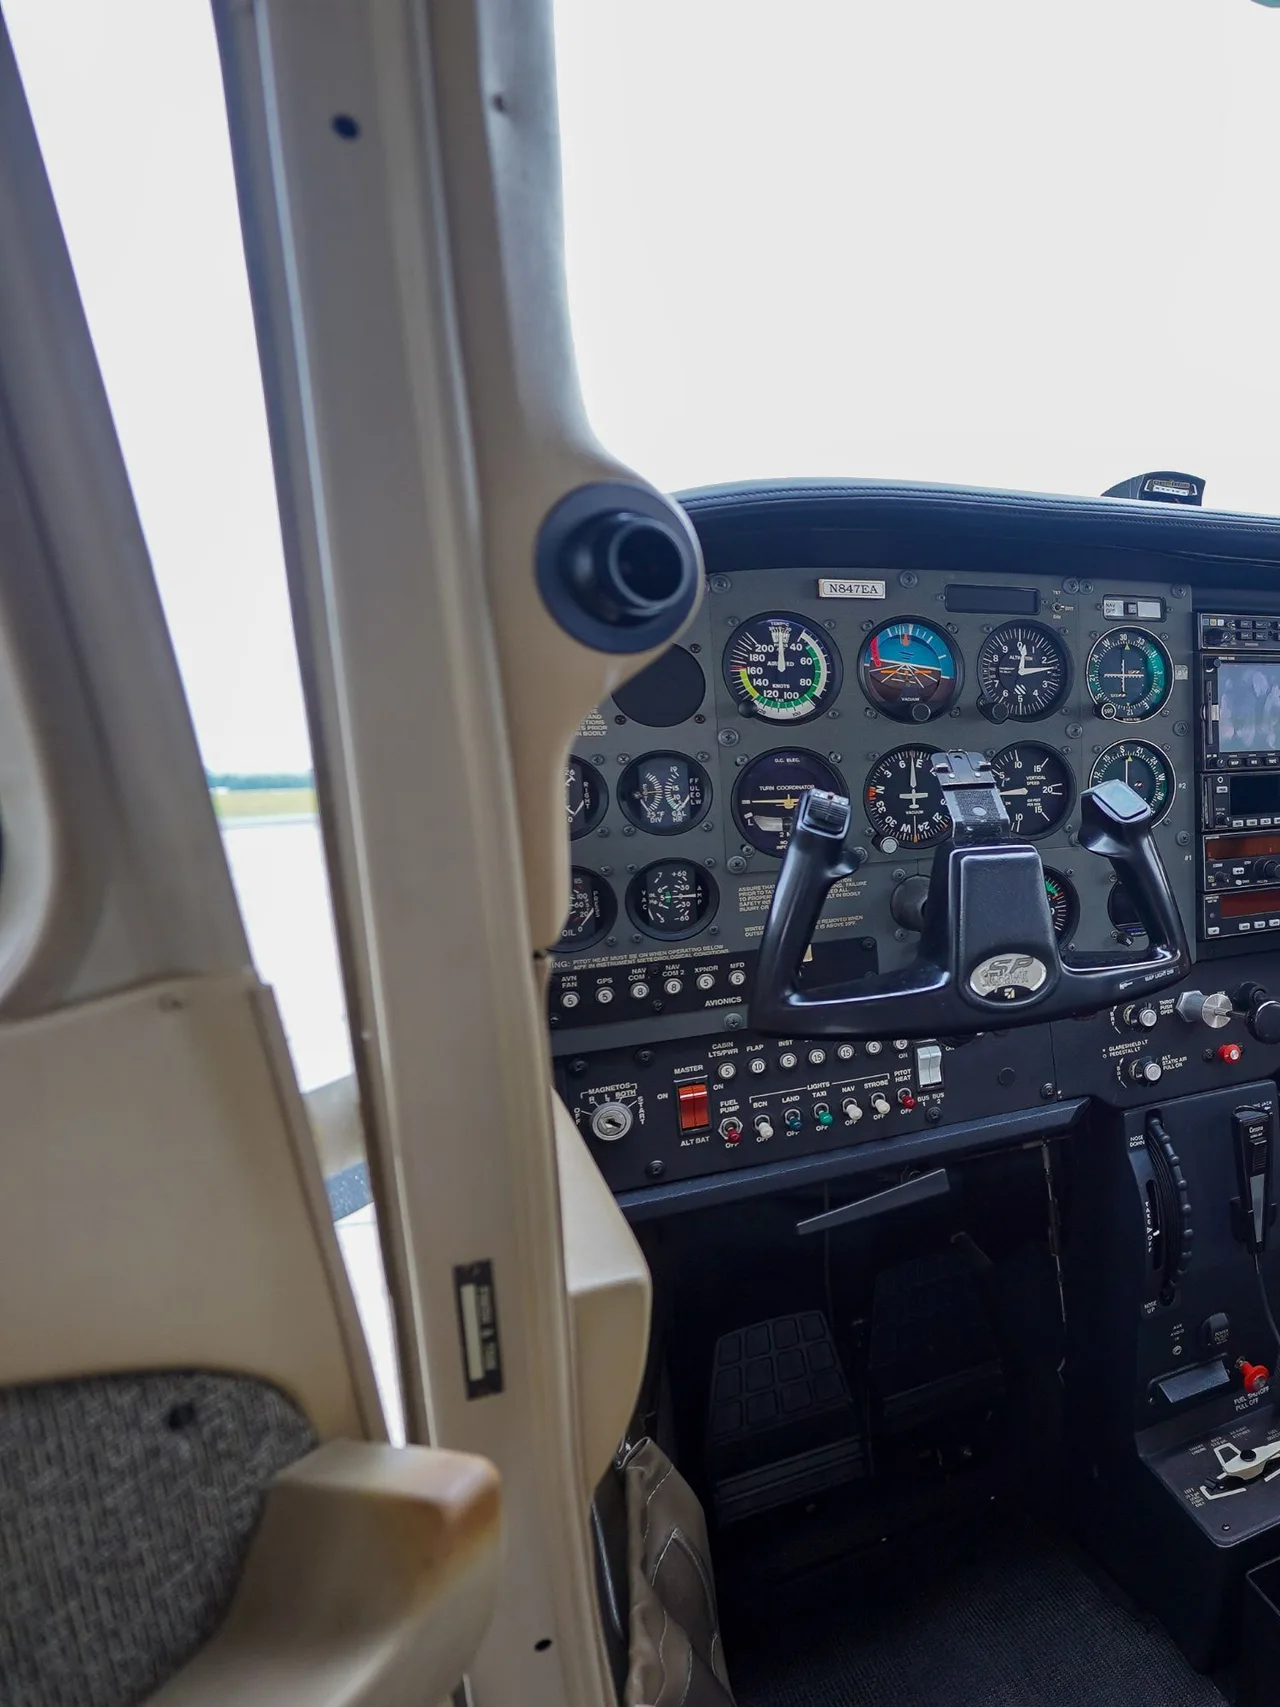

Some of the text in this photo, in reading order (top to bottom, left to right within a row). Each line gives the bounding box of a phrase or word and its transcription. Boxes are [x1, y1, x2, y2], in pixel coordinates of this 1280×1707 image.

[829, 583, 878, 594] N847EA
[790, 643, 803, 651] 40
[876, 801, 886, 813] 33
[885, 816, 897, 828] 30
[705, 996, 742, 1007] AVIONICS
[674, 1065, 703, 1074] MASTER
[588, 1082, 630, 1094] MAGNETOS
[807, 1082, 830, 1090] LIGHTS
[864, 1080, 888, 1089] STROBE
[720, 1106, 739, 1114] PUMP
